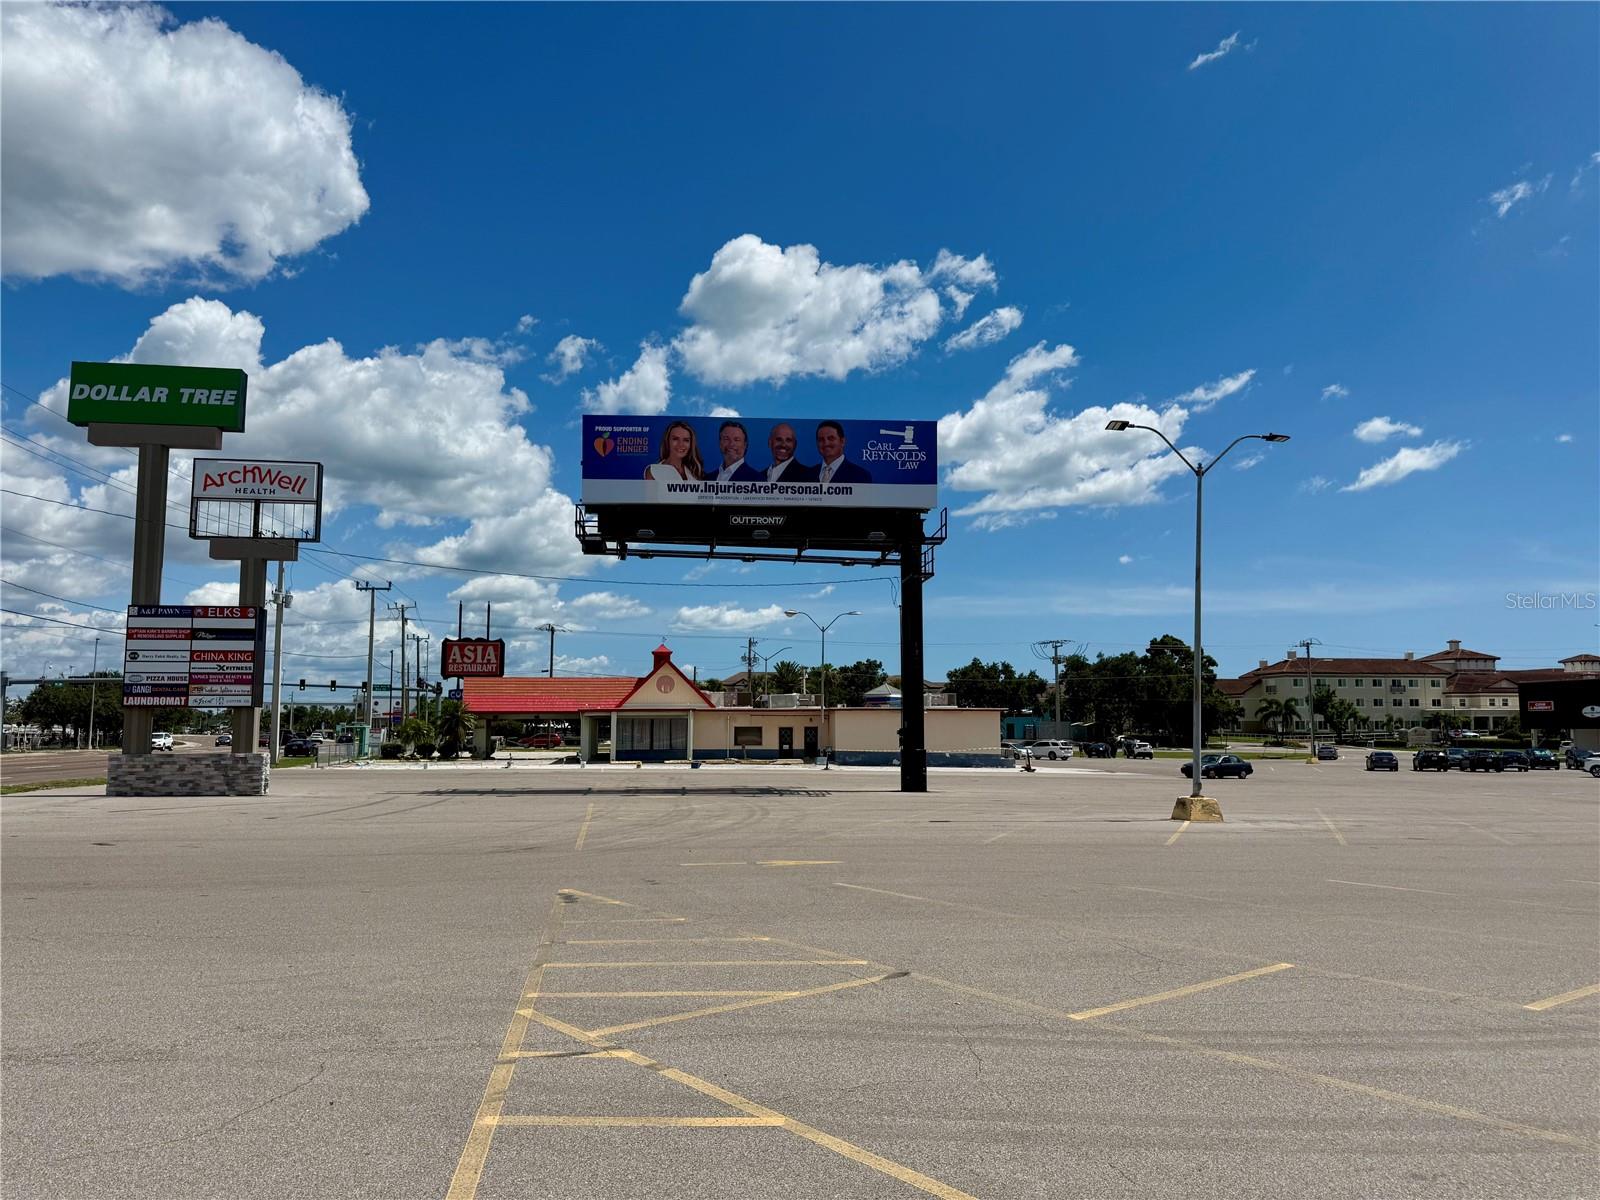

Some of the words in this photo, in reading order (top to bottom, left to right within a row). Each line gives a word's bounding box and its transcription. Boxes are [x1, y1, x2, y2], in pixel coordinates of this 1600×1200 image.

[72, 384, 169, 403] DOLLAR
[179, 388, 238, 406] TREE
[616, 437, 649, 445] ENDING
[616, 445, 649, 453] HUNGER
[862, 449, 927, 461] REYNOLDS
[203, 464, 307, 495] ArchWell
[235, 487, 276, 495] HEALTH
[666, 481, 853, 496] www.InjuriesArePersonal.com
[208, 607, 241, 617] ELKS
[193, 652, 224, 661] CHINA
[228, 652, 252, 661] KING
[448, 645, 497, 663] ASIA
[448, 664, 497, 672] RESTAURANT
[132, 685, 152, 694] GANGI
[123, 696, 187, 706] LAUNDROMAT
